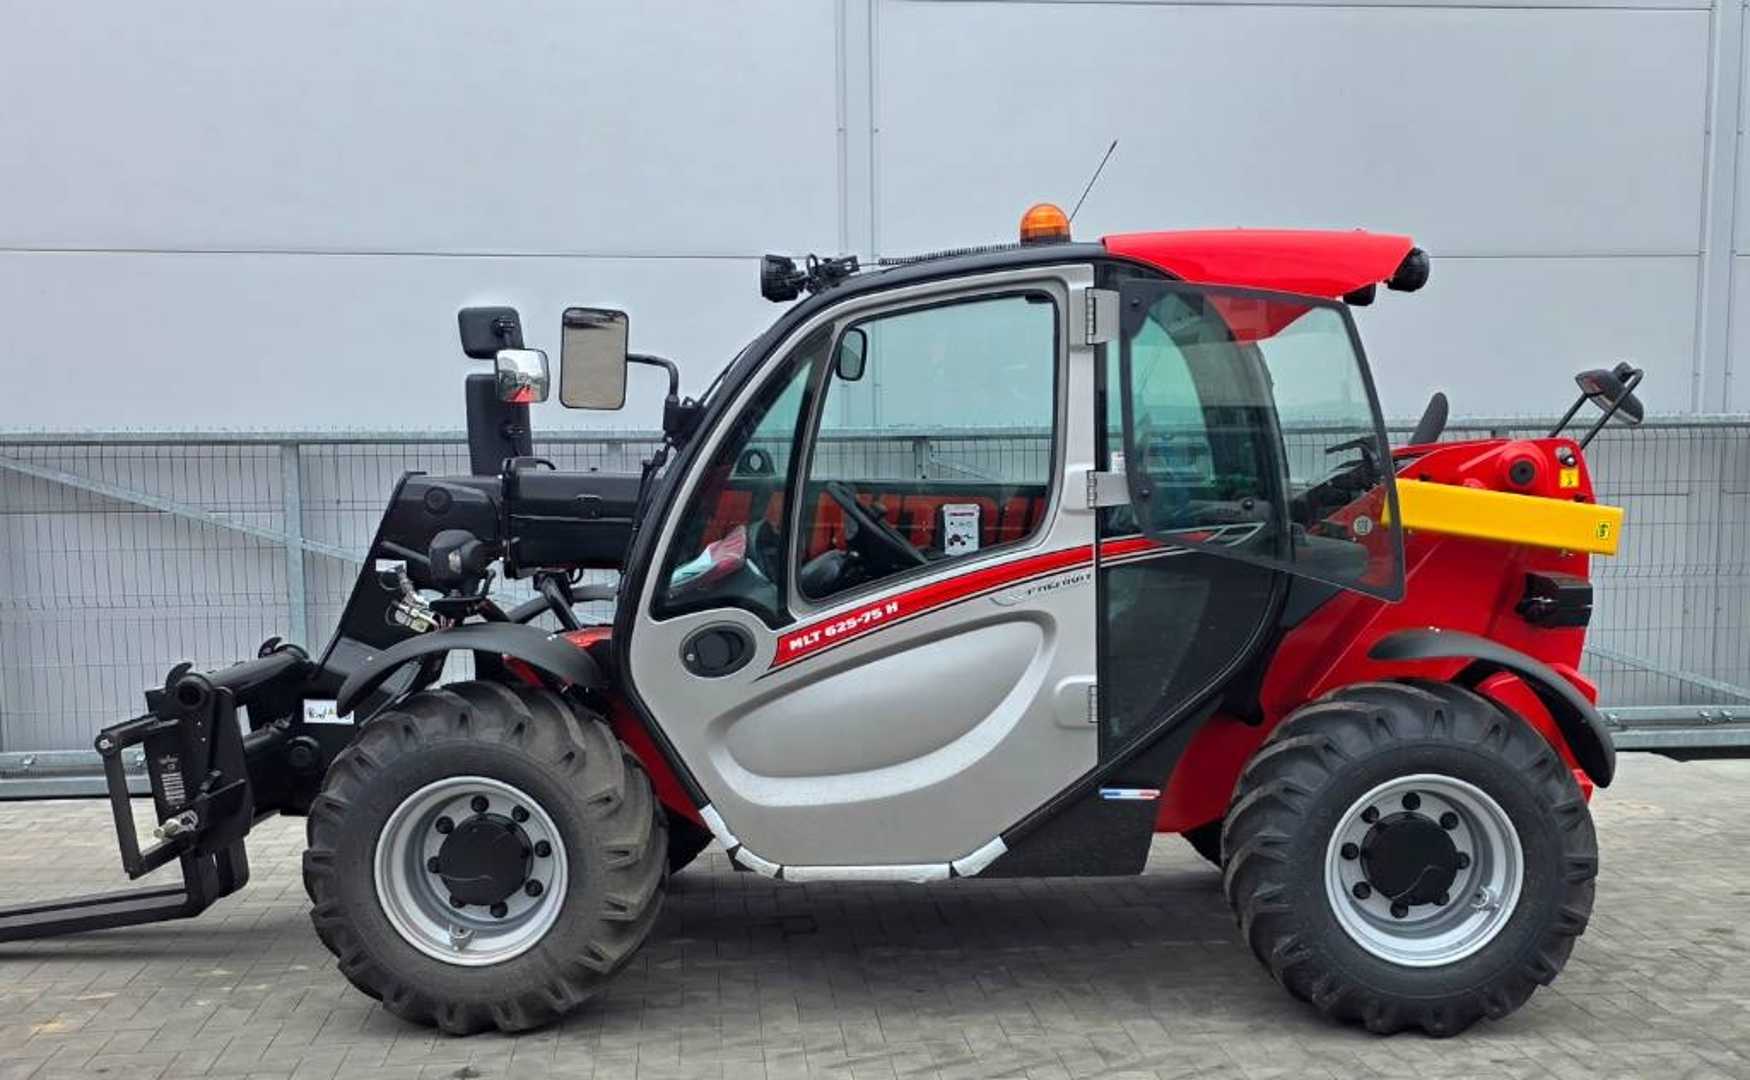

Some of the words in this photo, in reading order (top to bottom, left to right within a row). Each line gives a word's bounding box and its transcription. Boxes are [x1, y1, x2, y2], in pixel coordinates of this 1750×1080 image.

[789, 630, 821, 651] MLT
[824, 608, 883, 637] 625-75
[885, 602, 899, 615] H
